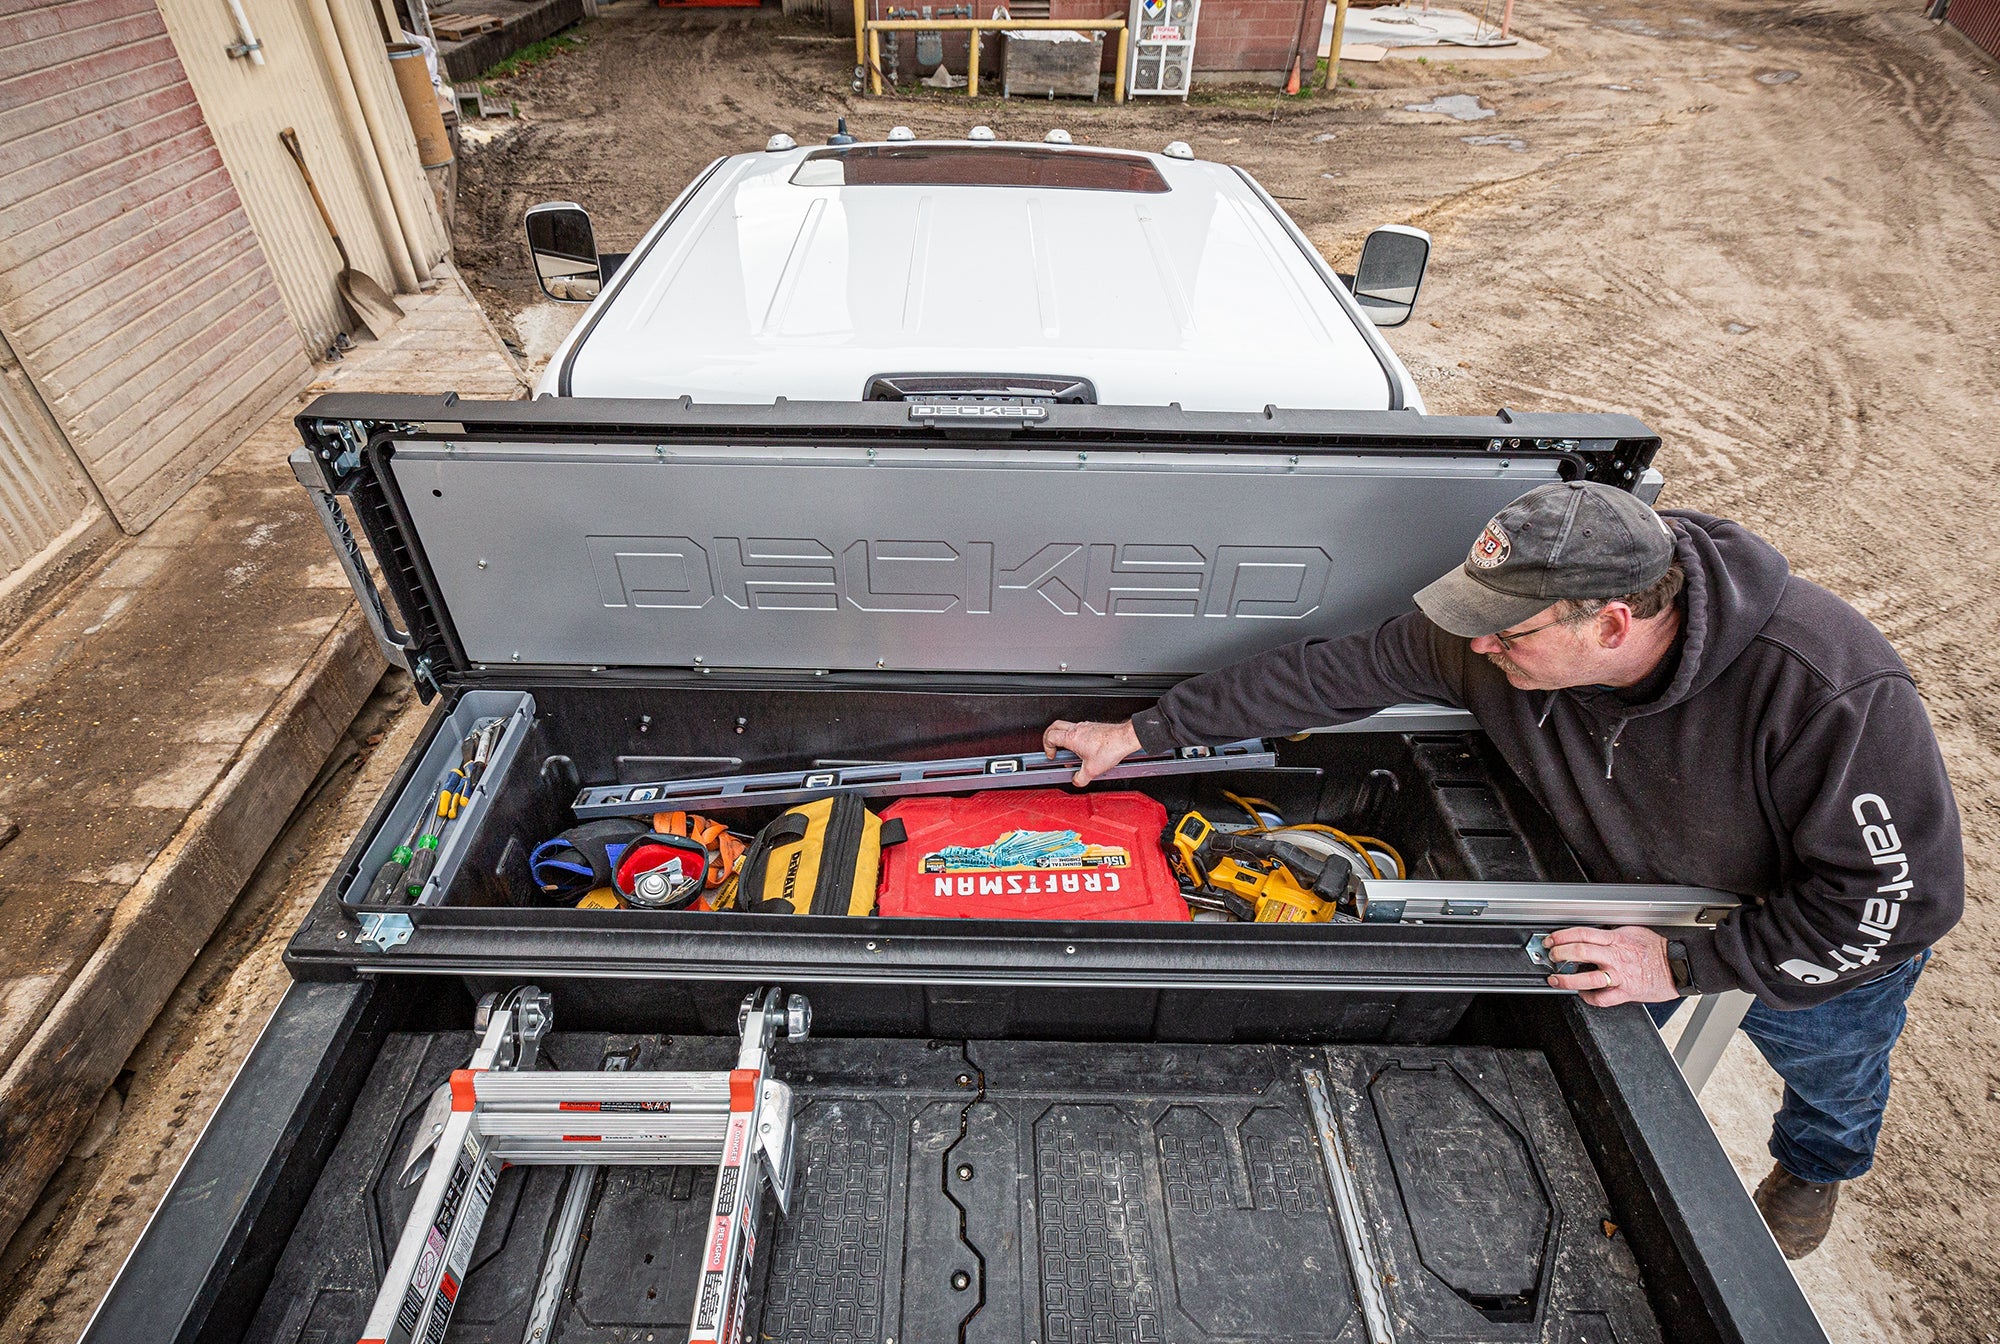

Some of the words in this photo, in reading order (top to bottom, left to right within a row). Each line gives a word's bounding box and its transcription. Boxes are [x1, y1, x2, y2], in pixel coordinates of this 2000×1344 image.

[914, 406, 1045, 416] DECKED
[584, 534, 1334, 619] DECKED
[934, 872, 1121, 897] CRAFTSMAN
[1828, 793, 1915, 973] carhartt
[730, 1130, 741, 1162] DANGER
[713, 1227, 726, 1265] PELIGRO
